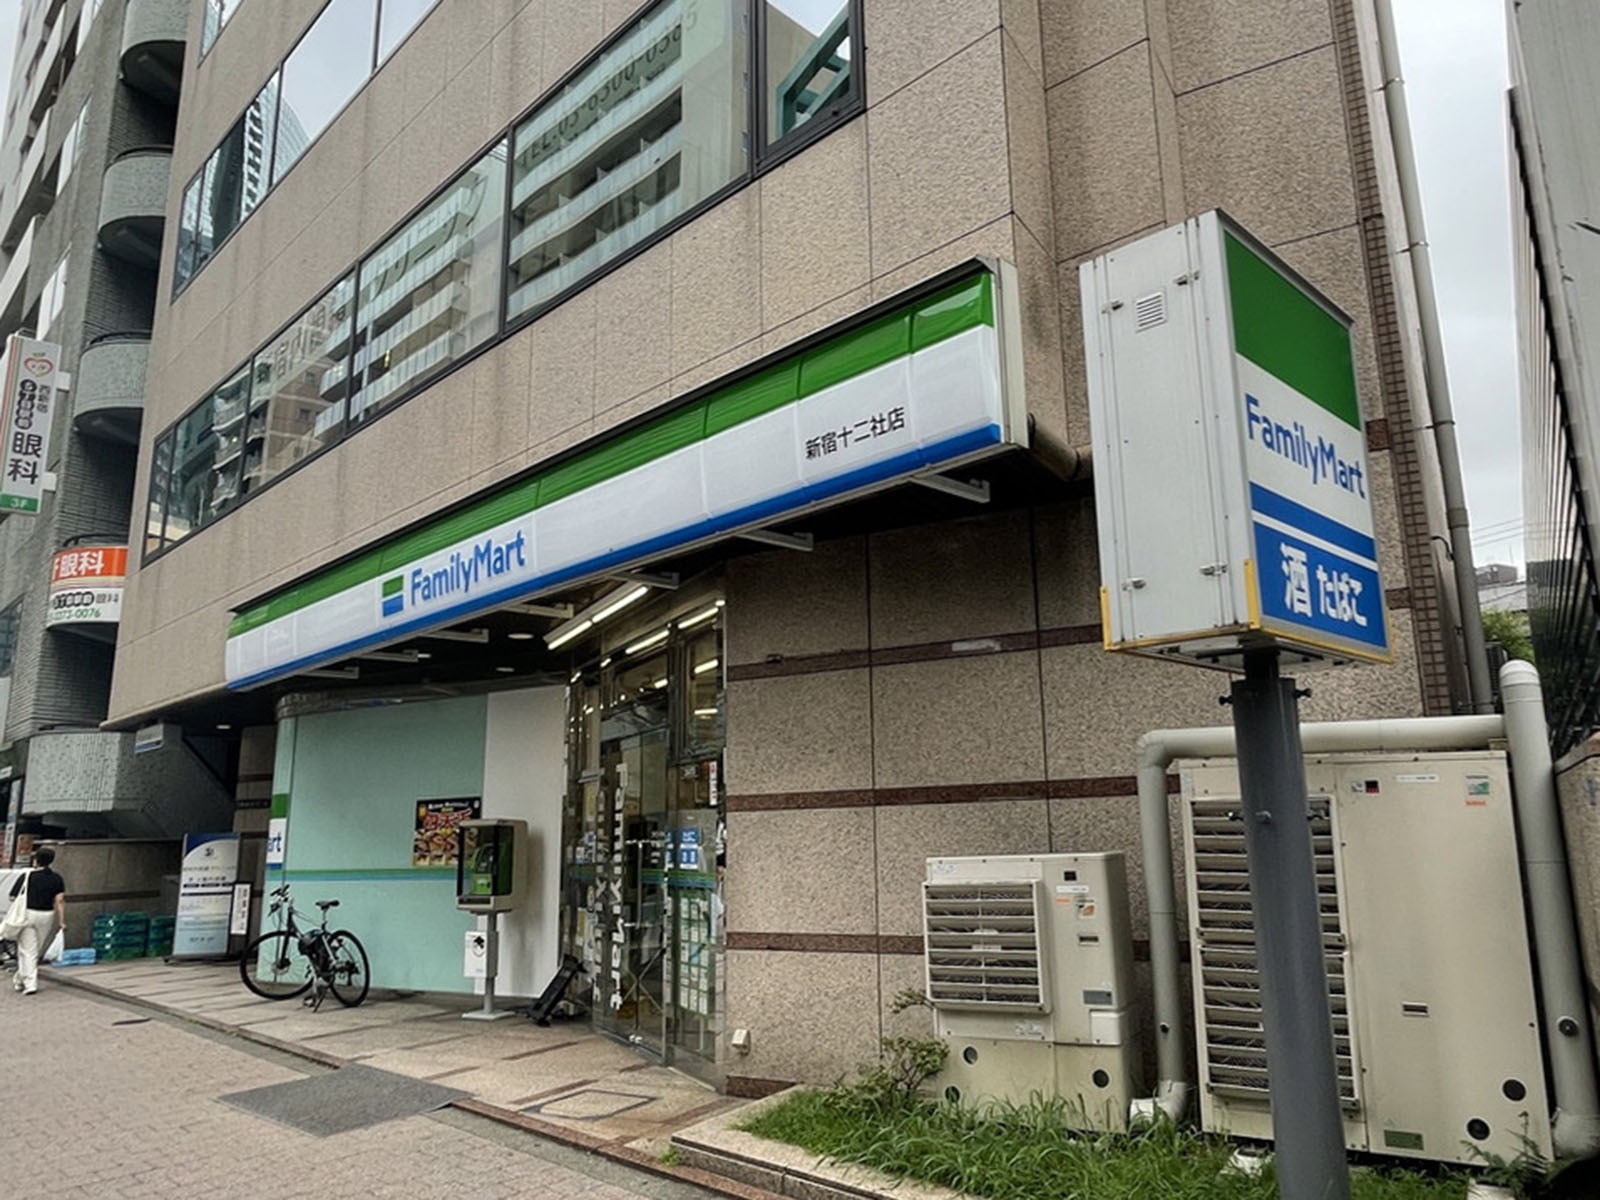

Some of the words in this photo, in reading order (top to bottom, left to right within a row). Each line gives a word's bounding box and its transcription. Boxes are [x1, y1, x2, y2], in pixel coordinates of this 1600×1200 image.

[8, 432, 43, 485] 眼科
[804, 407, 905, 460] 新宿十二社店
[1245, 393, 1365, 499] FamilyMart
[411, 530, 526, 606] FamilyMart
[1280, 542, 1312, 617] 酒
[1316, 564, 1368, 627] たばこ
